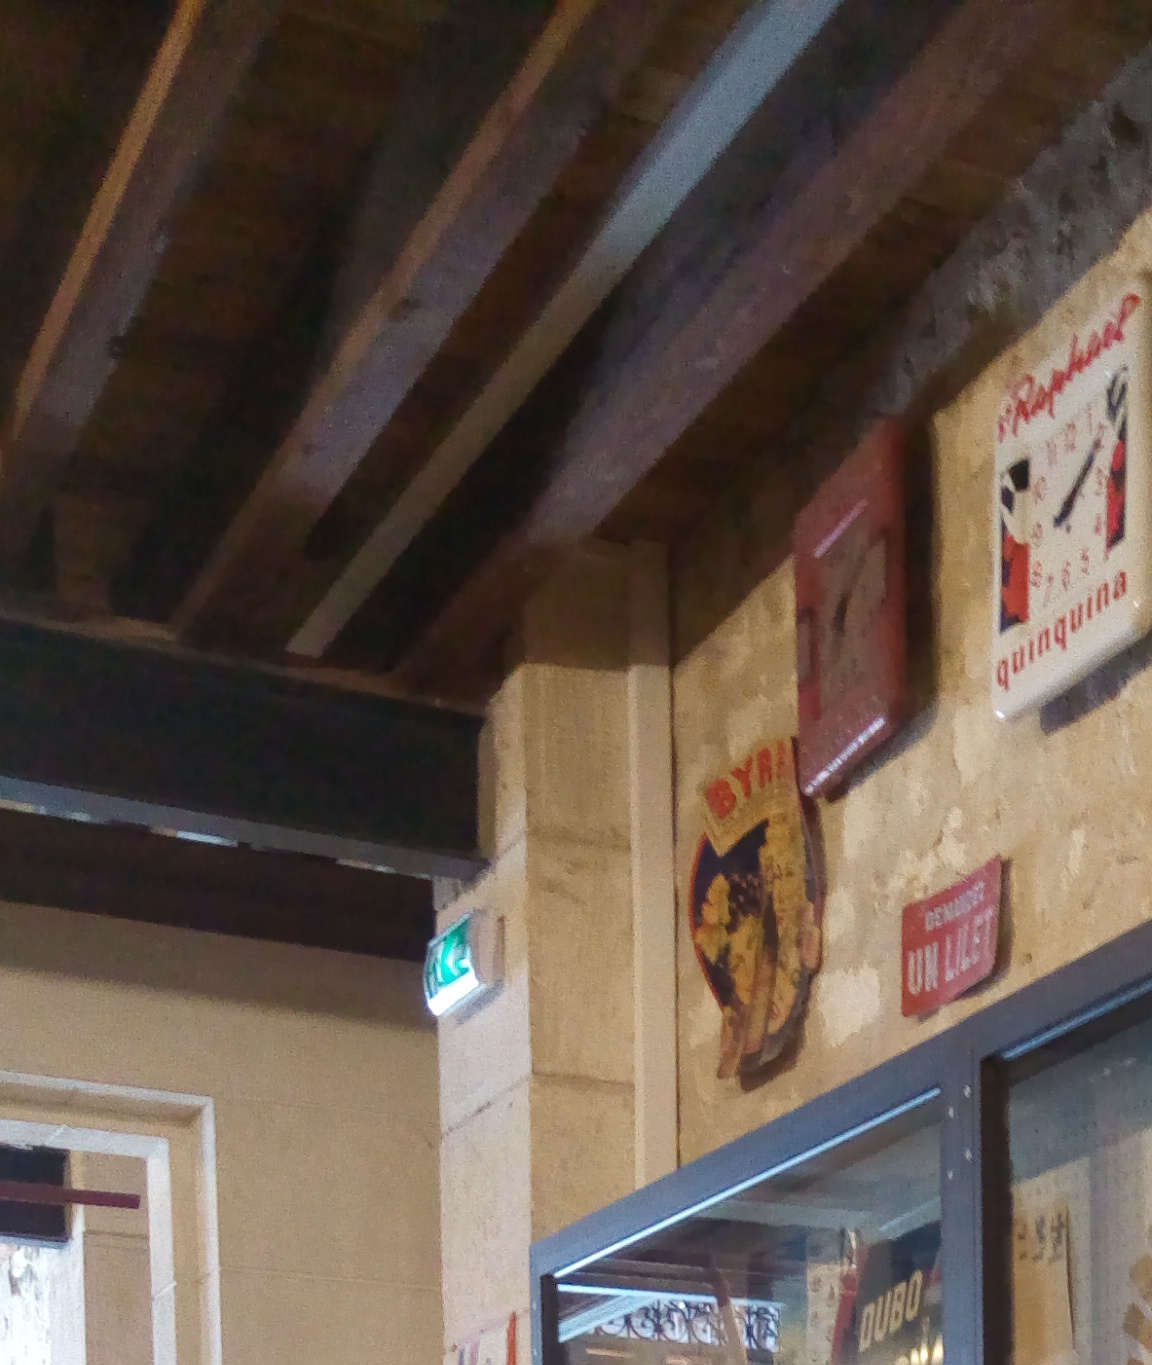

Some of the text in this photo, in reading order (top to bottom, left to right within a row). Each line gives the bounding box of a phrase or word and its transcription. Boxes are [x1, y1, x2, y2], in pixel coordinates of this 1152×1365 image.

[997, 571, 1128, 692] quinquina
[907, 941, 939, 996] UN
[859, 1269, 924, 1352] DUBO
